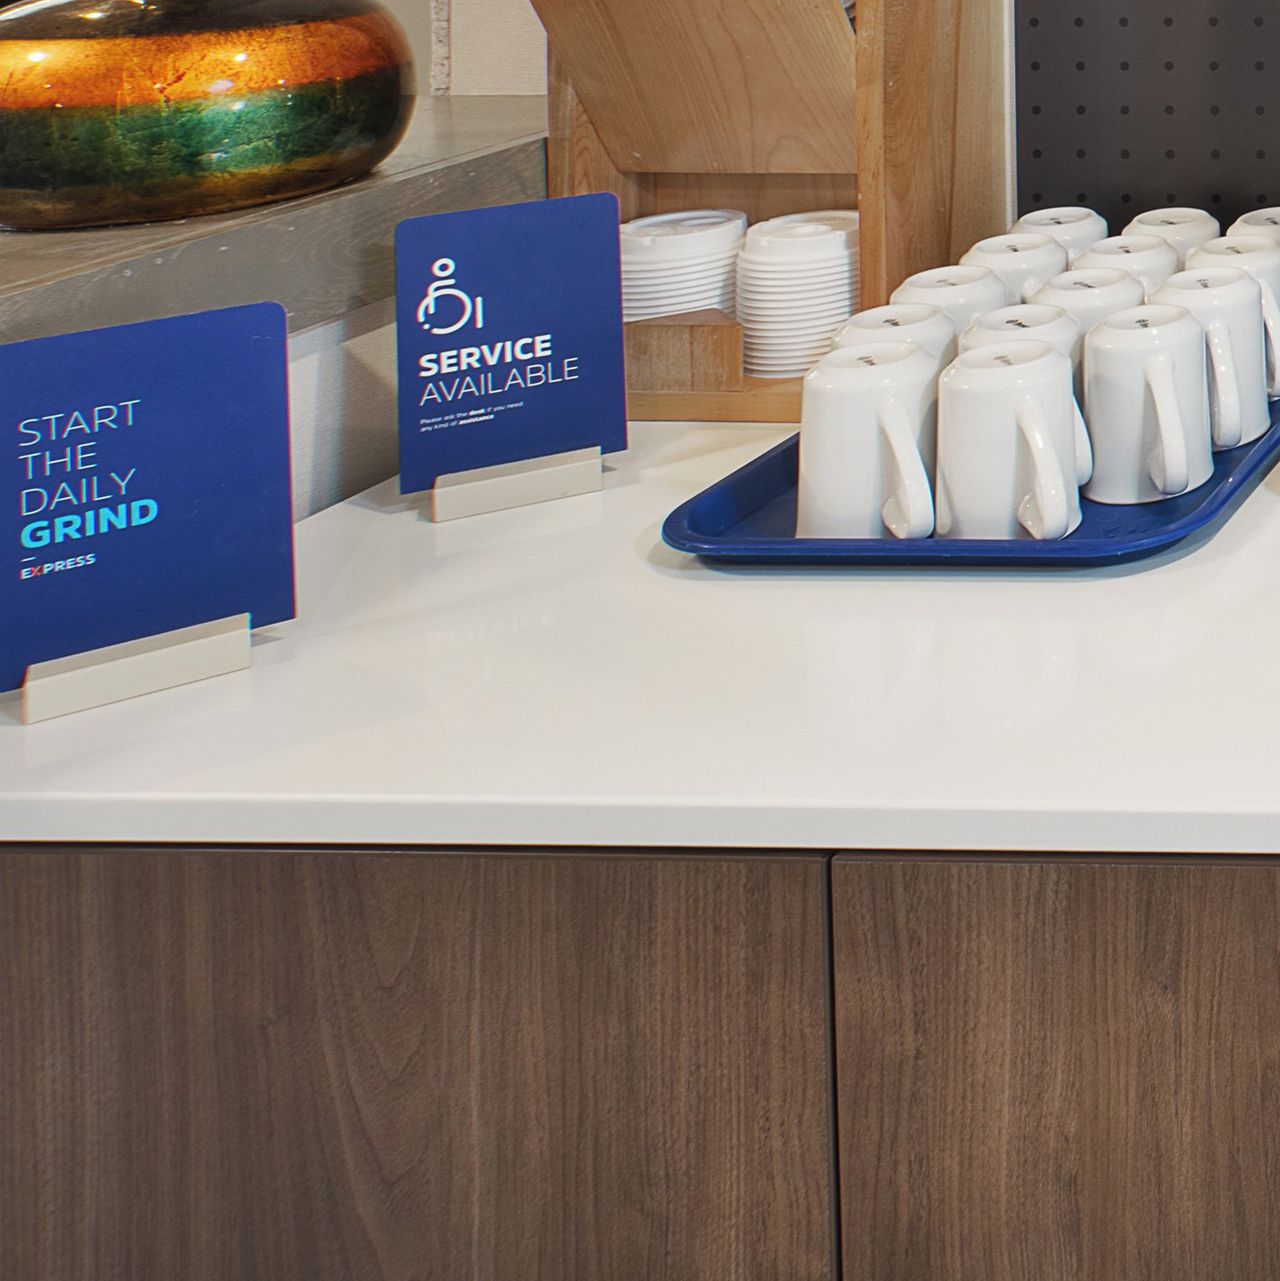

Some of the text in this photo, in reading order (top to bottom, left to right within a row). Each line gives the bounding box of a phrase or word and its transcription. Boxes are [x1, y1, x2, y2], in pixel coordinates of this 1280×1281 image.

[418, 334, 552, 377] SERVICE
[419, 357, 579, 406] AVAILABLE
[18, 399, 141, 446] START
[18, 442, 97, 480] THE
[20, 468, 136, 516] DAILY
[20, 498, 158, 549] GRIND
[19, 553, 96, 580] EXPRESS
